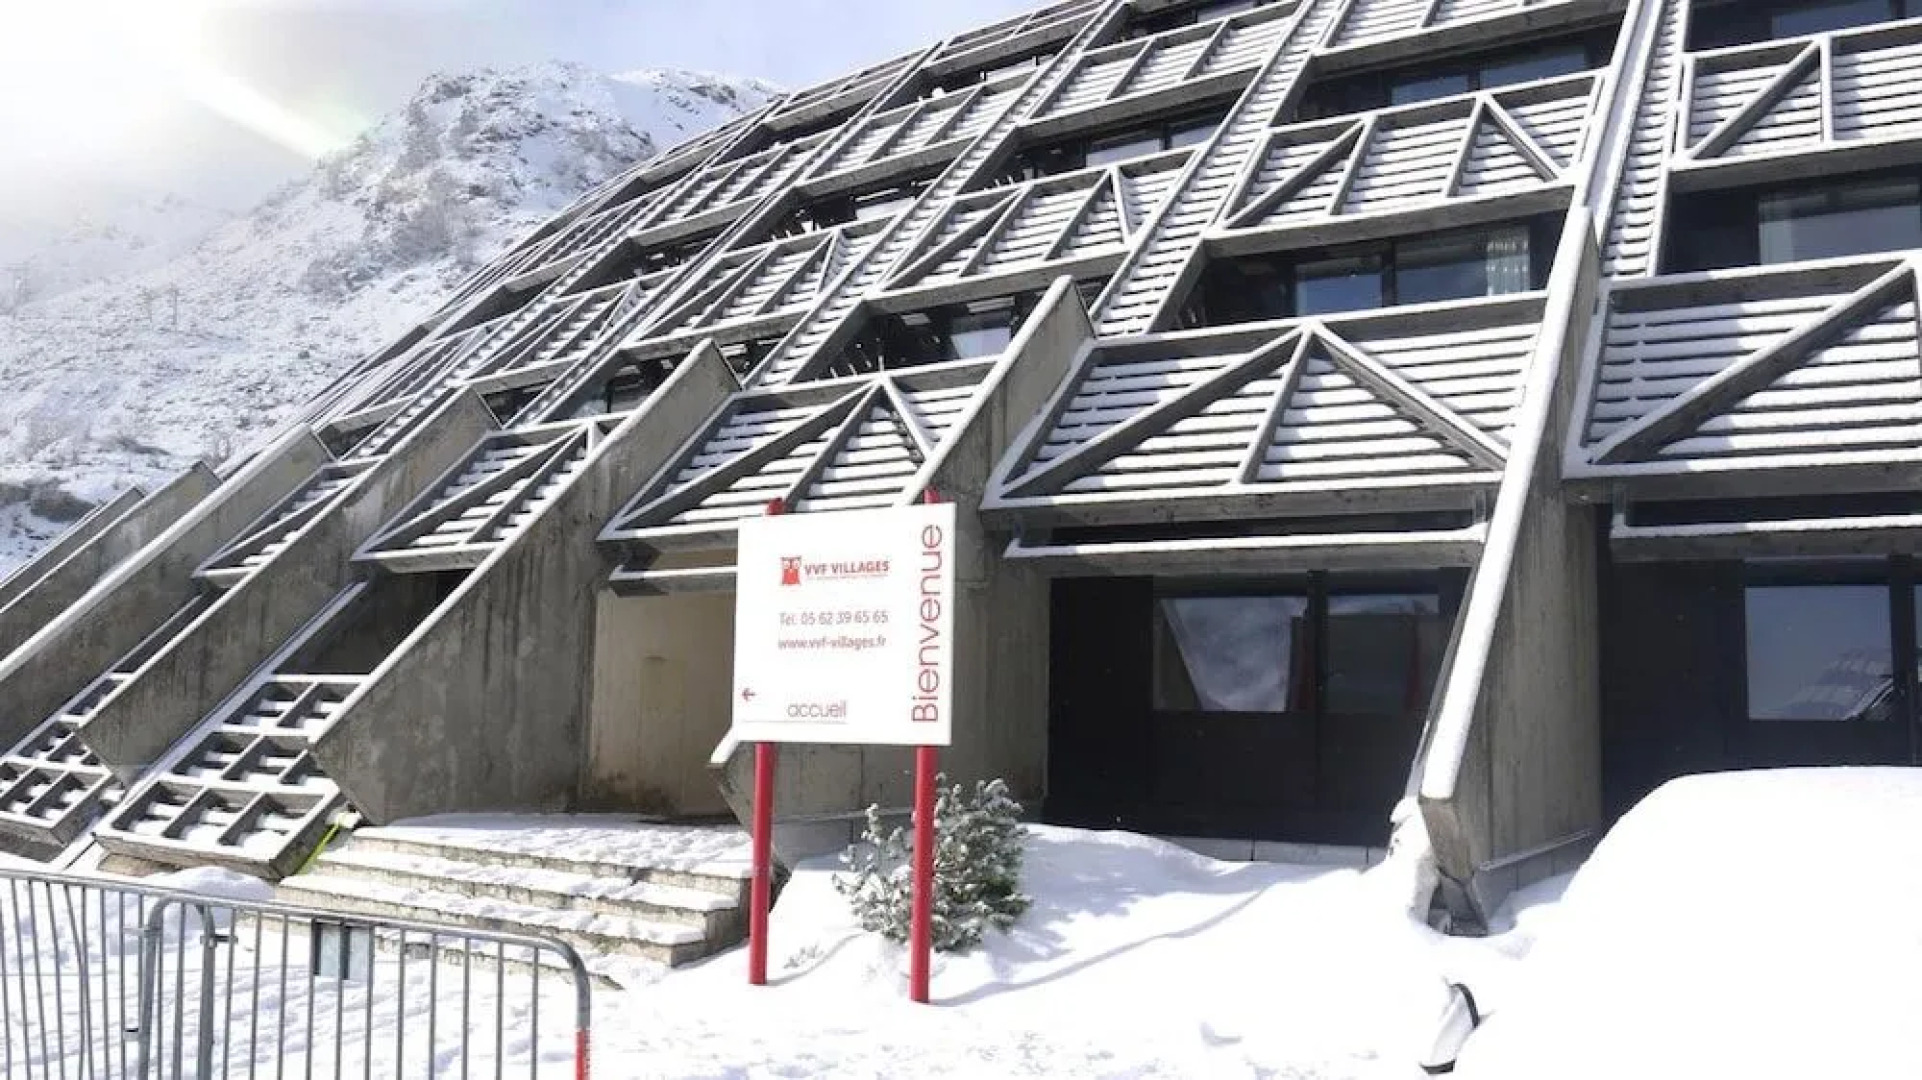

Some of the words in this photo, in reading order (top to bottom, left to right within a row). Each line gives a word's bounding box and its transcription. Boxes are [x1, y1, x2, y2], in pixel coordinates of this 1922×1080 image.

[804, 563, 827, 575] VVF
[831, 560, 890, 574] VILLAGES
[801, 611, 816, 625] 05
[819, 611, 833, 625] 62
[836, 610, 852, 625] 39
[855, 610, 869, 624] 65
[873, 609, 889, 624] 65
[911, 523, 943, 723] Bienvenue
[787, 699, 847, 718] accueil
